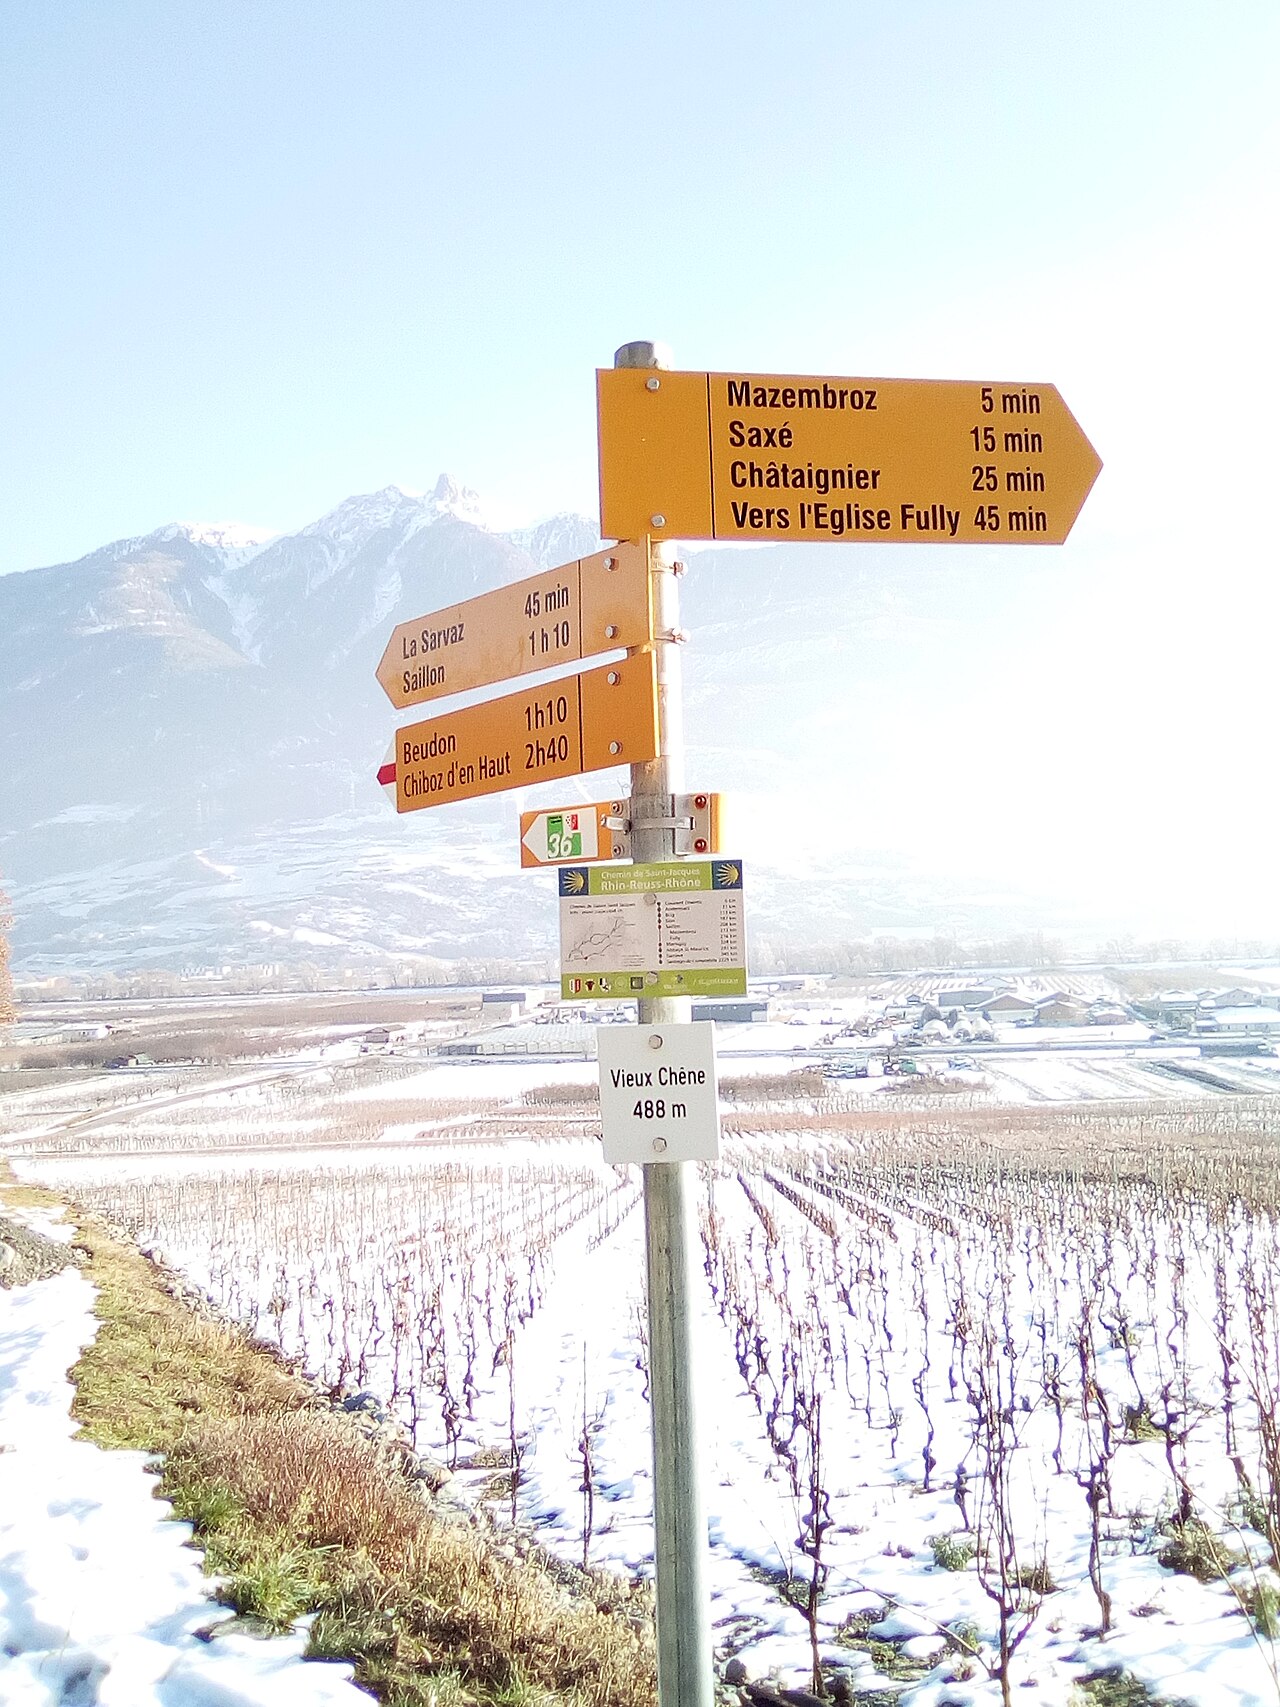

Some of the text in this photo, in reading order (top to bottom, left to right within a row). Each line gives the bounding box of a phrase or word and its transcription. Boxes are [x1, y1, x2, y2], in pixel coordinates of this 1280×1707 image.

[728, 381, 1040, 413] Mazembroz 5 min
[730, 421, 1042, 452] Saxé 15 min
[731, 461, 1044, 494] Châtaignier 25 min
[731, 502, 1046, 536] Vers l'Eglise Fully 45 min
[403, 584, 568, 659] La Sarvaz 45 min
[404, 621, 569, 693] Saillon 1 h 10
[403, 697, 566, 764] Beudon 1h10
[404, 735, 568, 797] Chiboz d'en Haut 2h40
[548, 834, 572, 857] 36
[601, 871, 631, 879] Chemin
[611, 1067, 705, 1087] Vieux Chêne
[634, 1100, 686, 1118] 488 m
